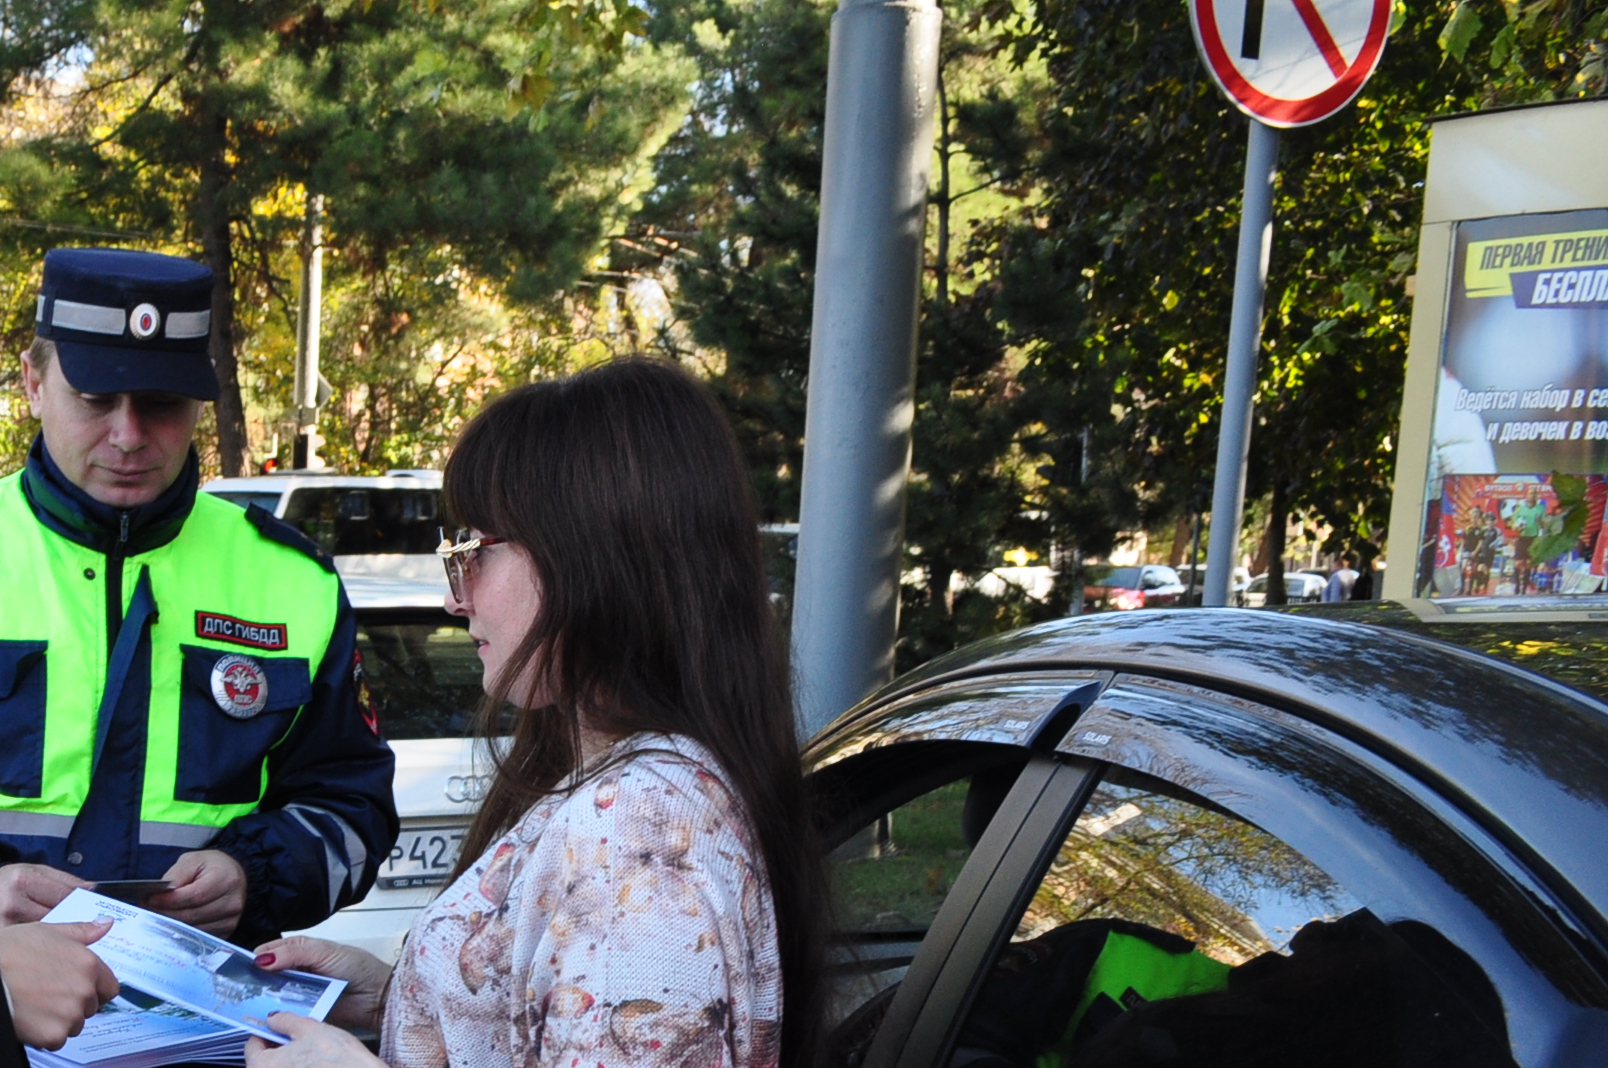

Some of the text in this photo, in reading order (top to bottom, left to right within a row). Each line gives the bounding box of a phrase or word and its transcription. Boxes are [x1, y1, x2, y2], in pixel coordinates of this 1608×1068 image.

[1479, 240, 1547, 271] ПЕРВАЯ
[1455, 383, 1608, 413] Ведётся набор в се
[1486, 421, 1499, 441] и
[1498, 420, 1570, 444] девочек
[1569, 420, 1584, 441] в
[203, 617, 281, 646] ДПС ГИБДД
